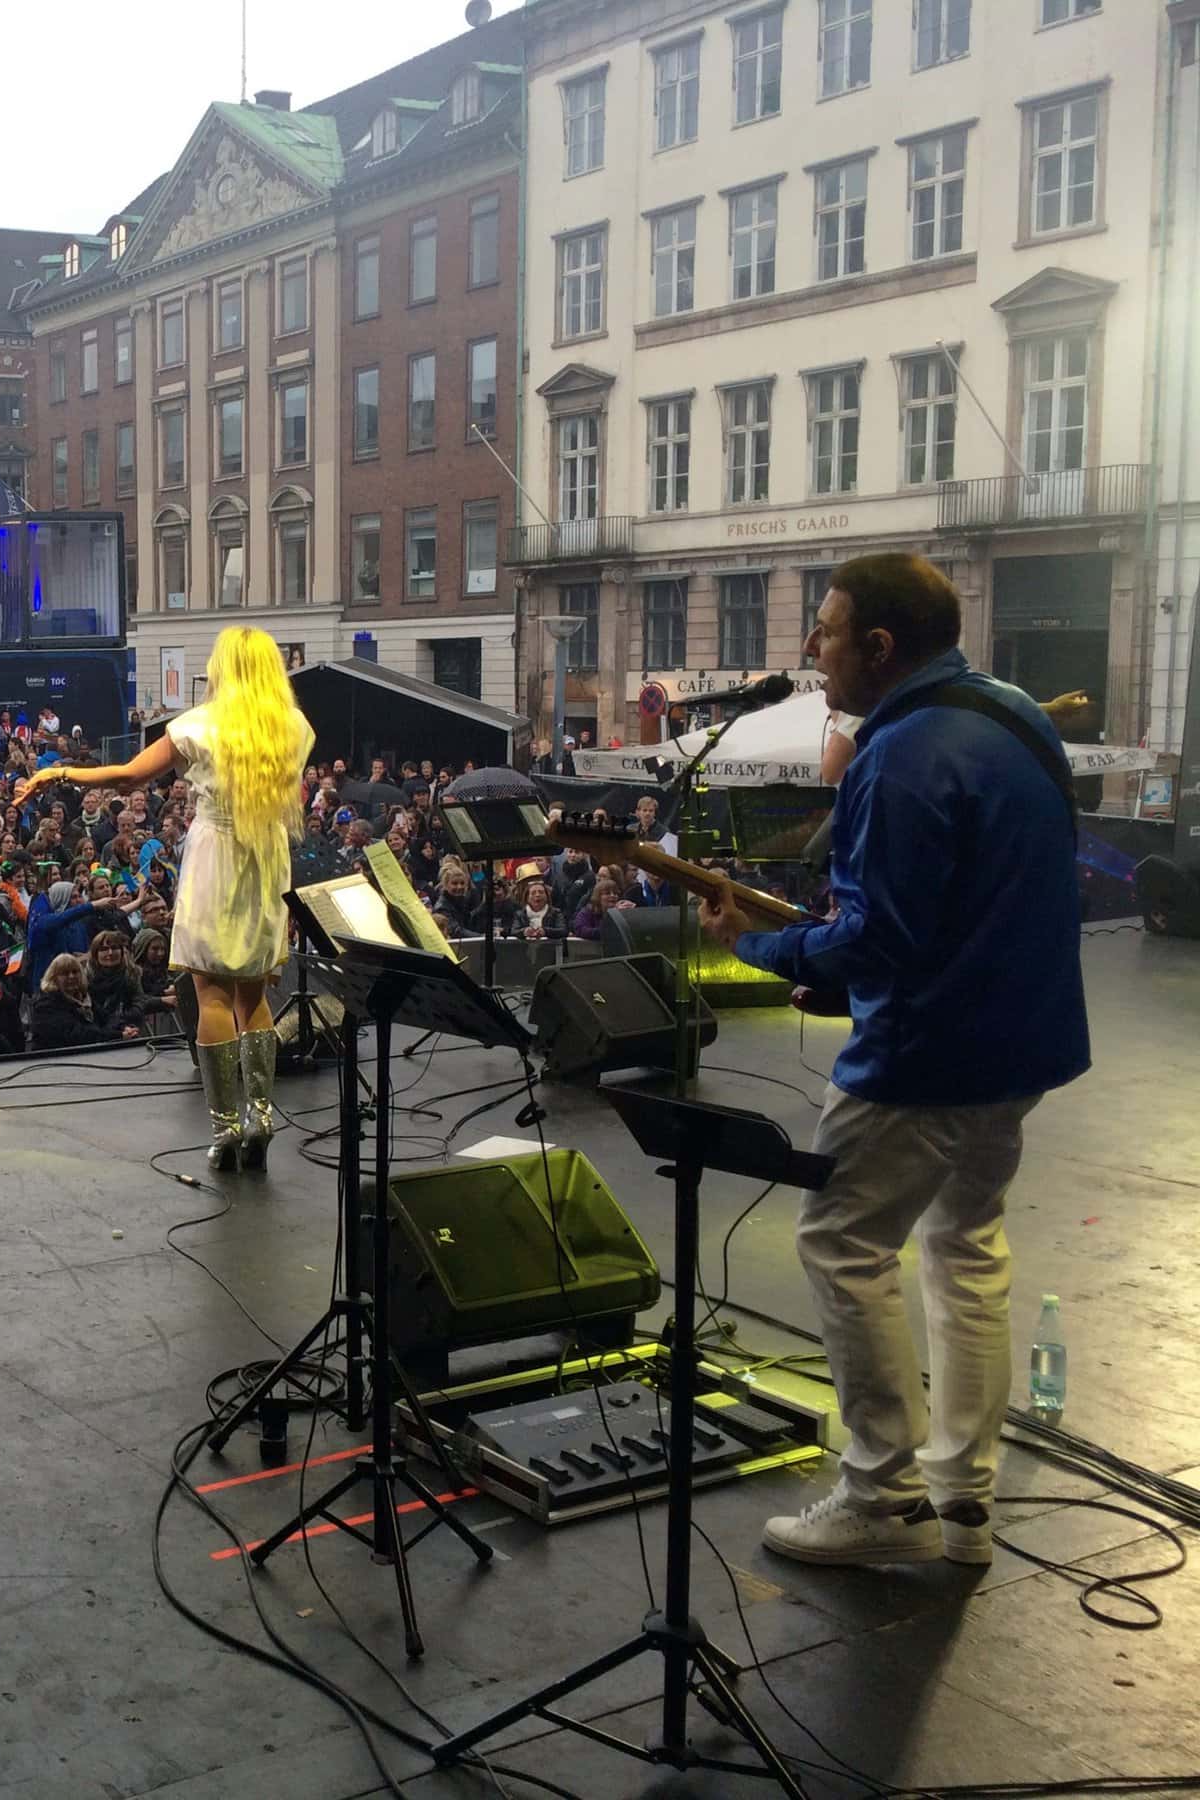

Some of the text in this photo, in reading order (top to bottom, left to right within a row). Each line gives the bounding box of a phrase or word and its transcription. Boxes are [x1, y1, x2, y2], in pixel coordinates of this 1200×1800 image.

[728, 515, 849, 537] FRISCH'S GAARD
[51, 677, 66, 686] TDC
[677, 677, 716, 693] CAFÉ
[1087, 752, 1116, 768] BAR
[779, 765, 812, 779] BAR
